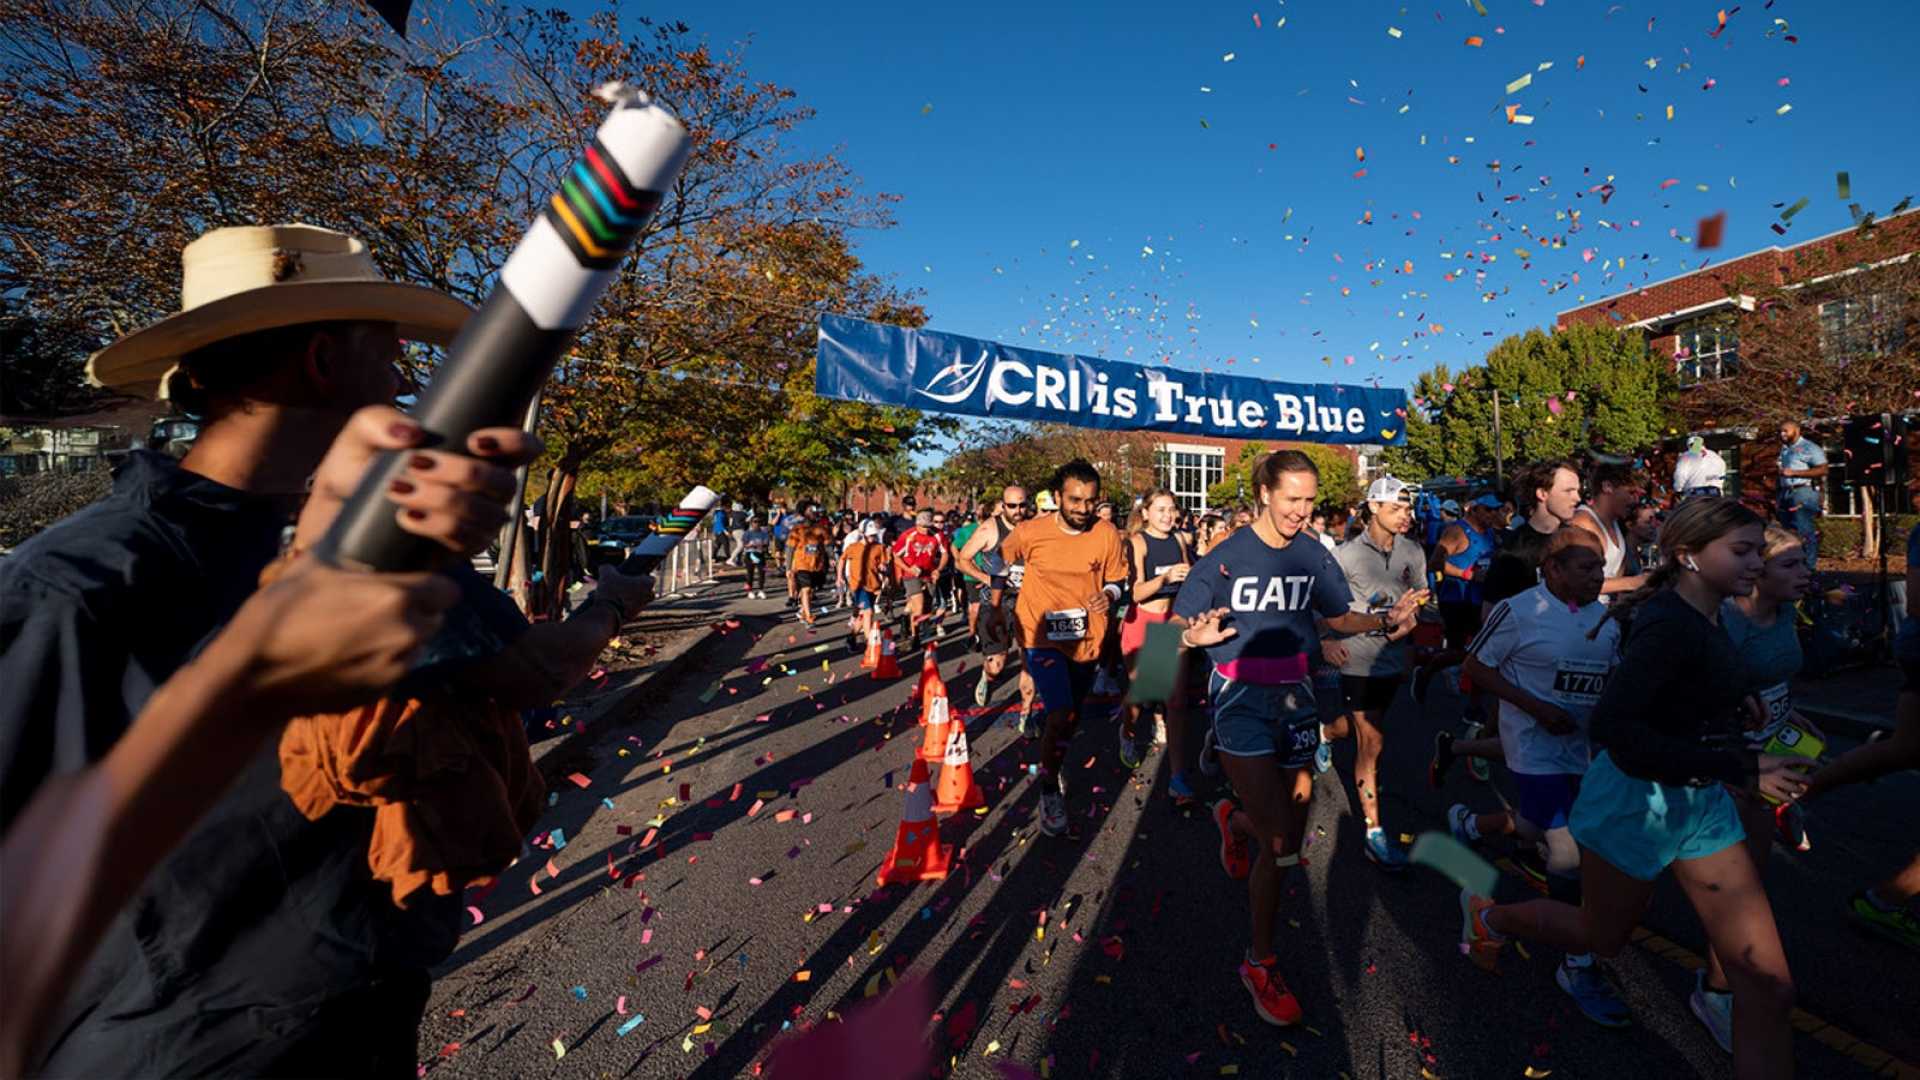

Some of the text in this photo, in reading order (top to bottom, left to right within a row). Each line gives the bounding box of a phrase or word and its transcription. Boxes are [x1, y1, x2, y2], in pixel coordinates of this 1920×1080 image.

[992, 361, 1365, 434] CRI is True Blue
[1562, 672, 1604, 693] 1770
